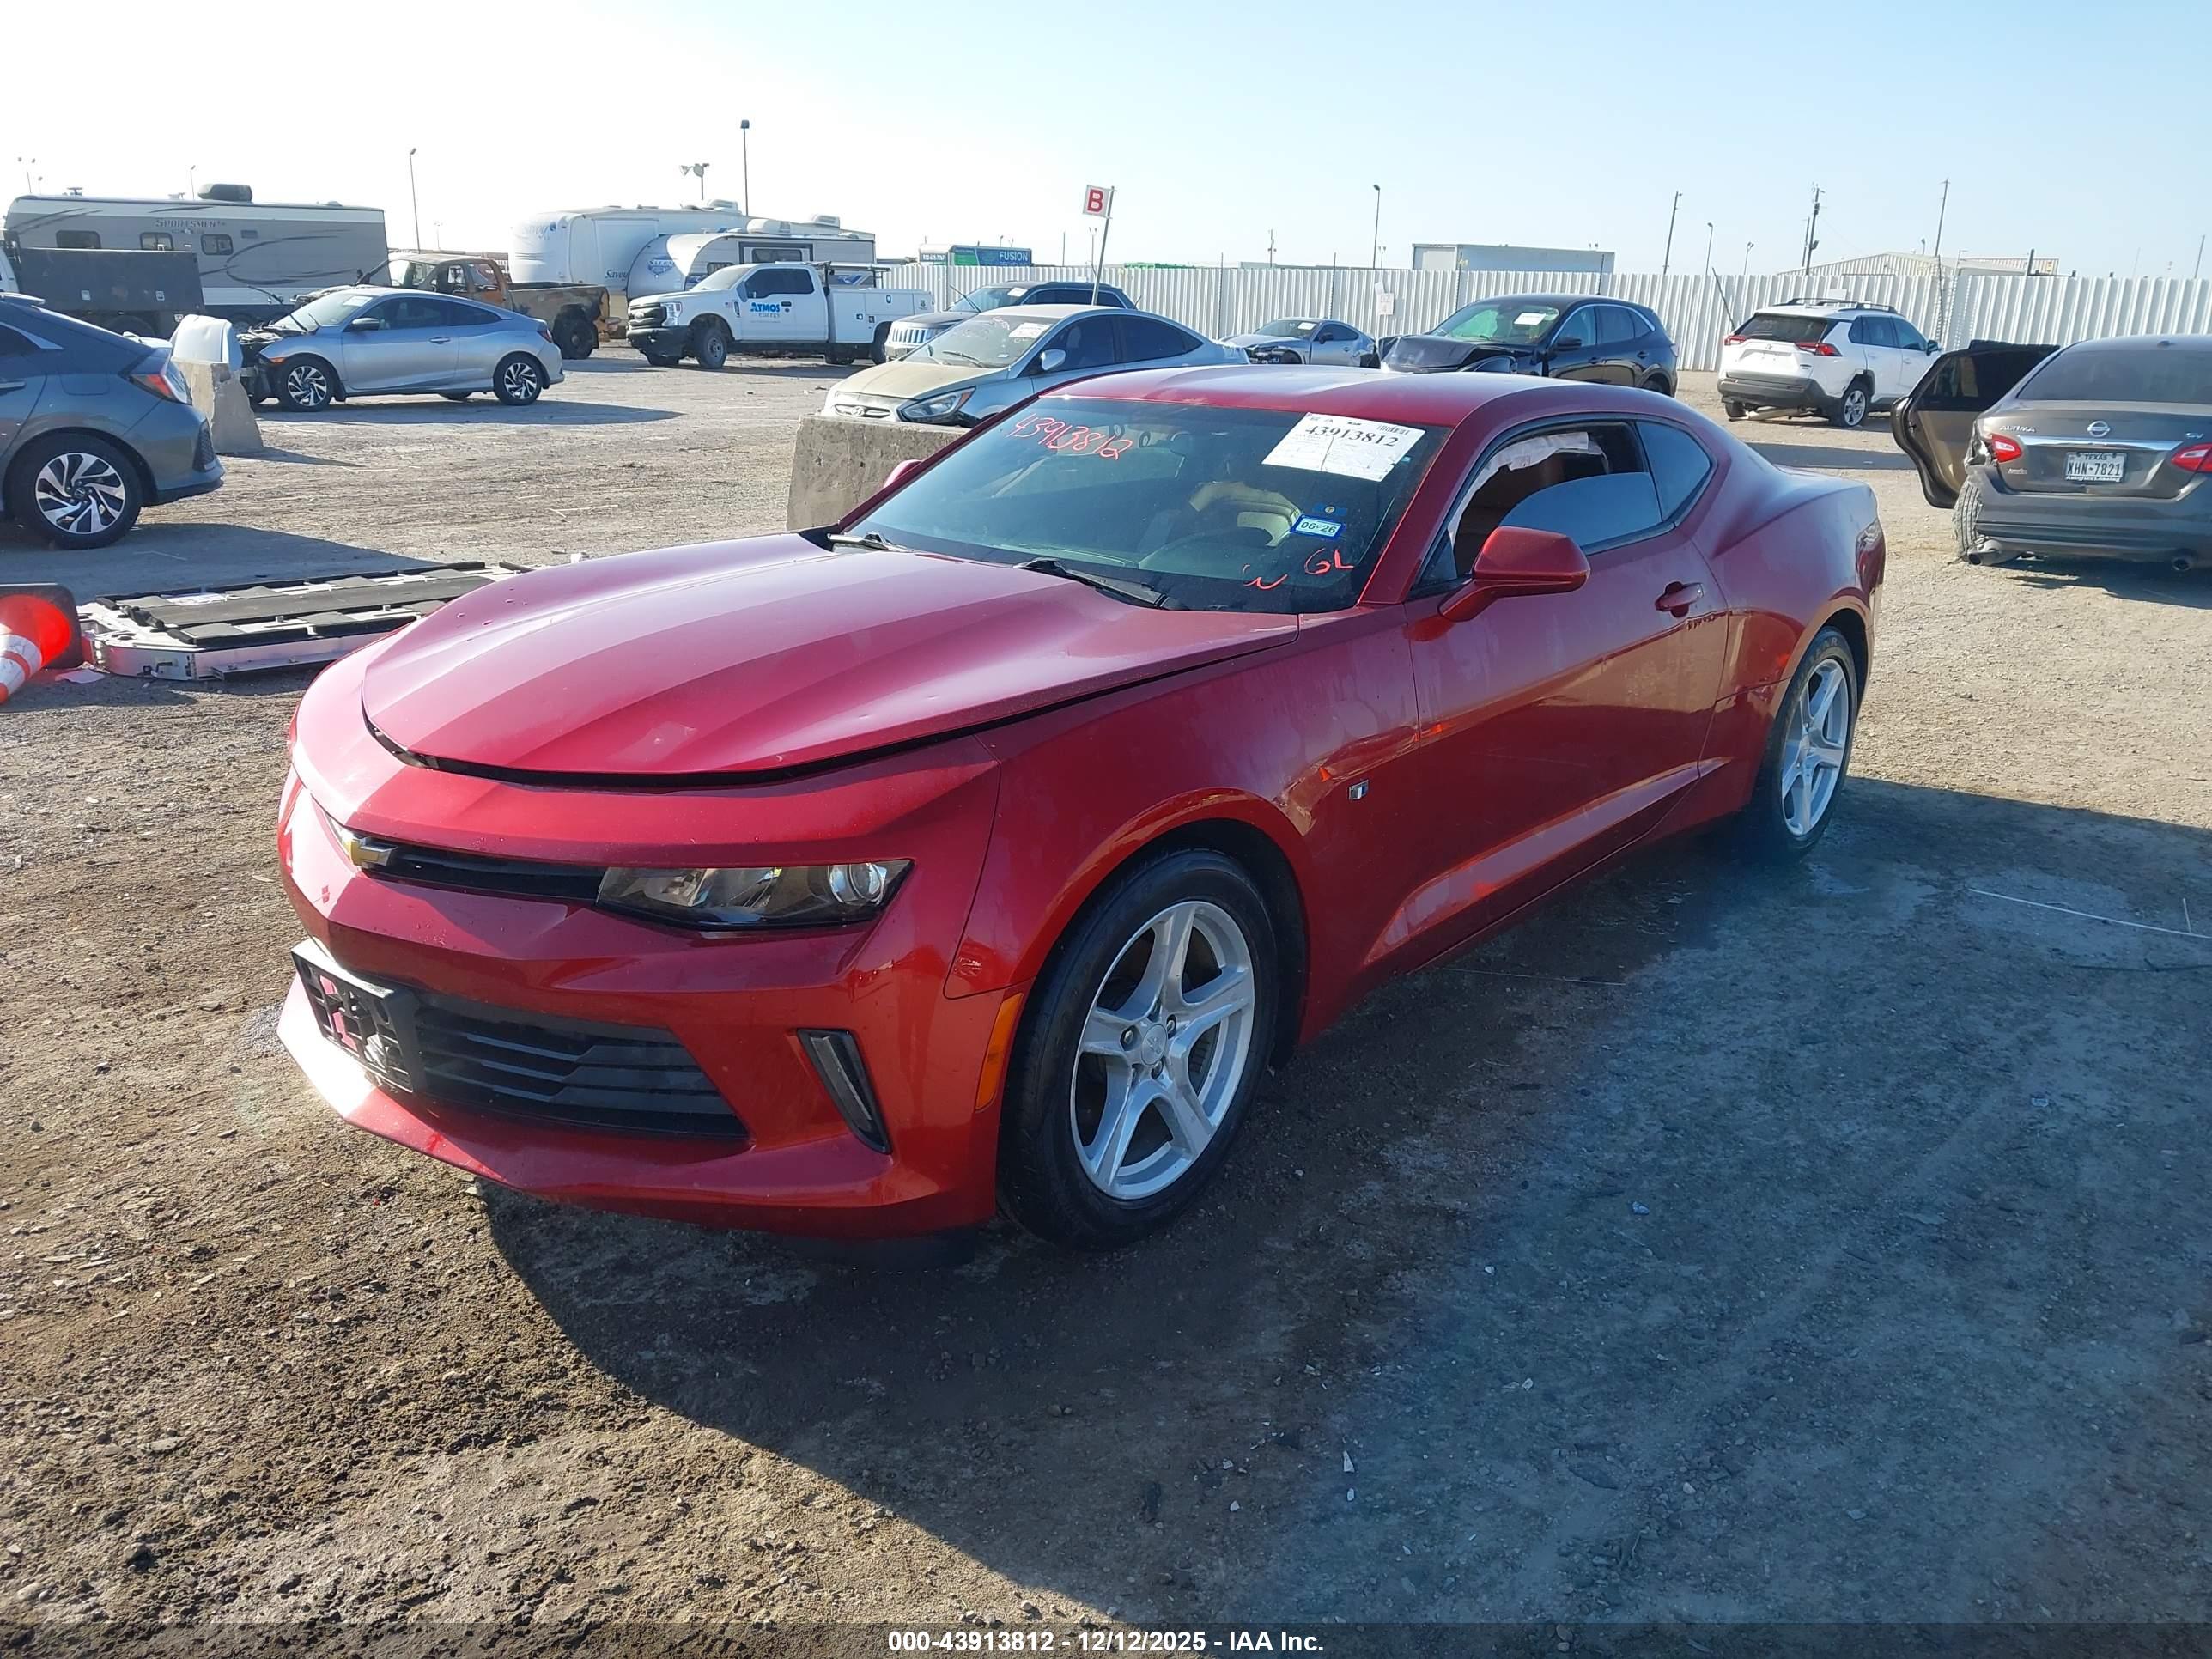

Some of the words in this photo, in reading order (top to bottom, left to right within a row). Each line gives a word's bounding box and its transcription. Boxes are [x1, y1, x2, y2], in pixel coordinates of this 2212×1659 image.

[1087, 189, 1104, 213] B
[1000, 251, 1029, 261] FUSION
[750, 302, 781, 313] ATMOS
[1005, 413, 1133, 460] 43913812
[1305, 425, 1399, 447] 43913812
[1300, 520, 1316, 530] 06
[1320, 524, 1337, 533] 26
